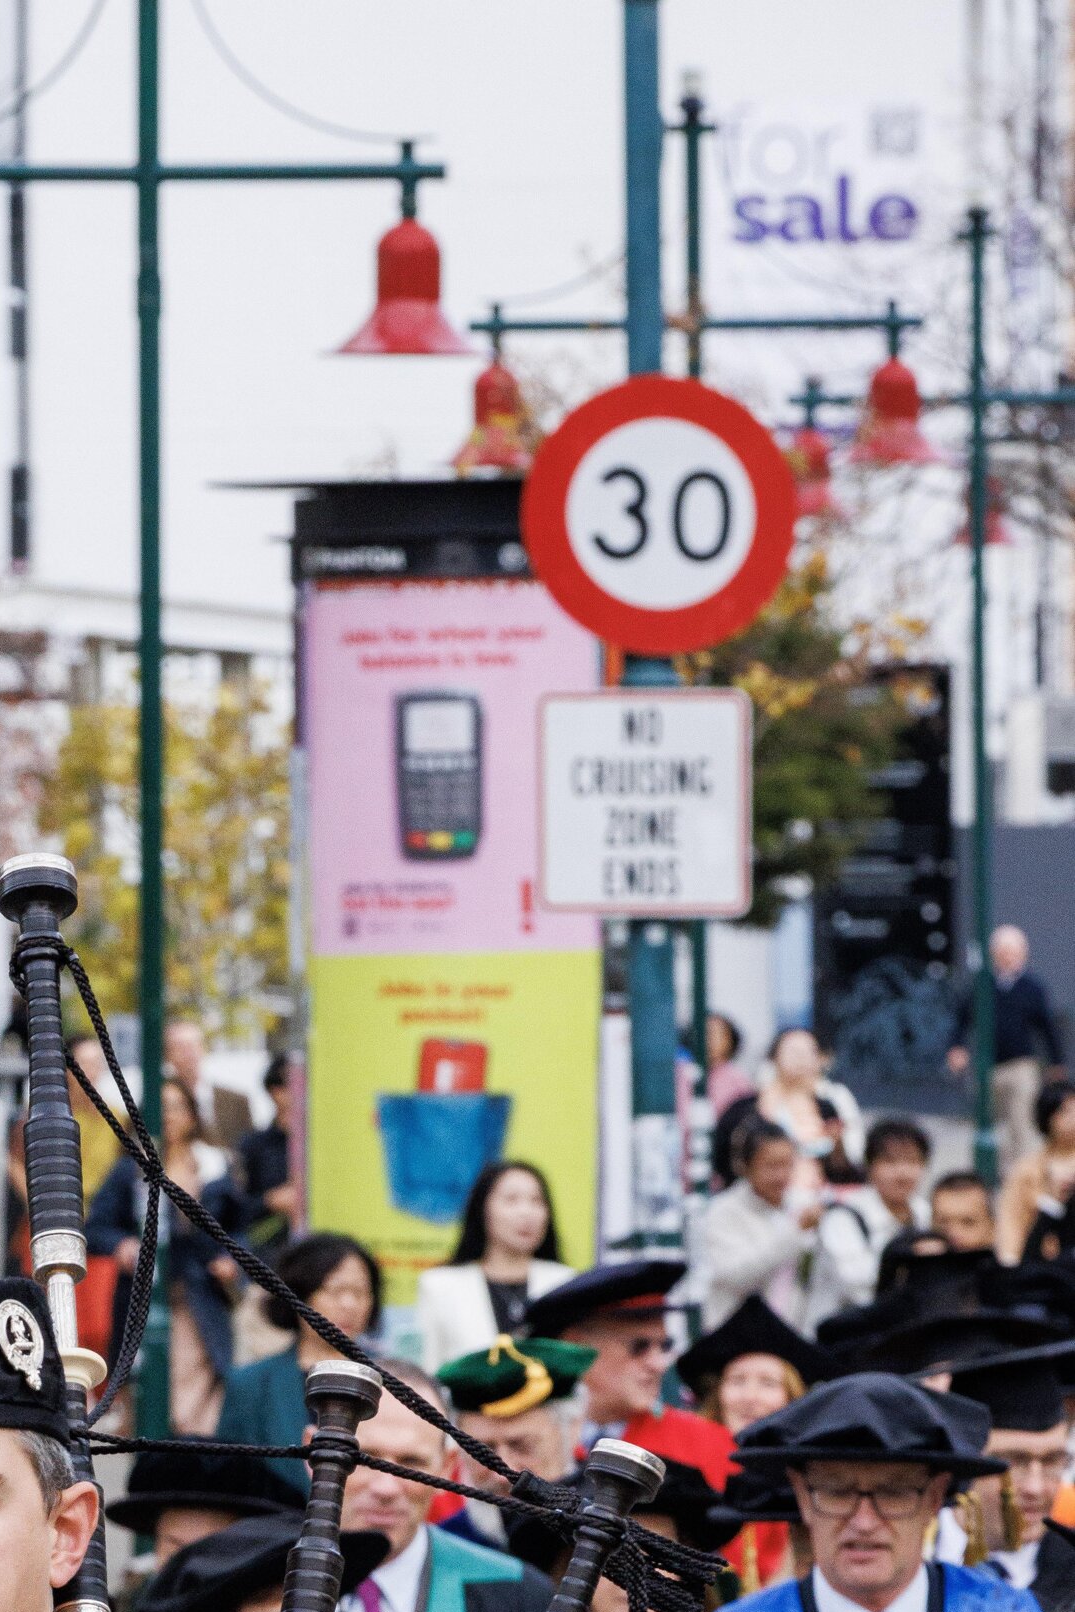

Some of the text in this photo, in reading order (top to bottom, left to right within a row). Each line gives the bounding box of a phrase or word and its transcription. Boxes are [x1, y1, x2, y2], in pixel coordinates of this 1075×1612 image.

[733, 172, 918, 243] sale
[593, 466, 730, 562] 30
[622, 708, 663, 745] NO
[571, 757, 712, 797] CRUISING
[605, 808, 678, 847] ZONE
[604, 857, 681, 895] ENDS
